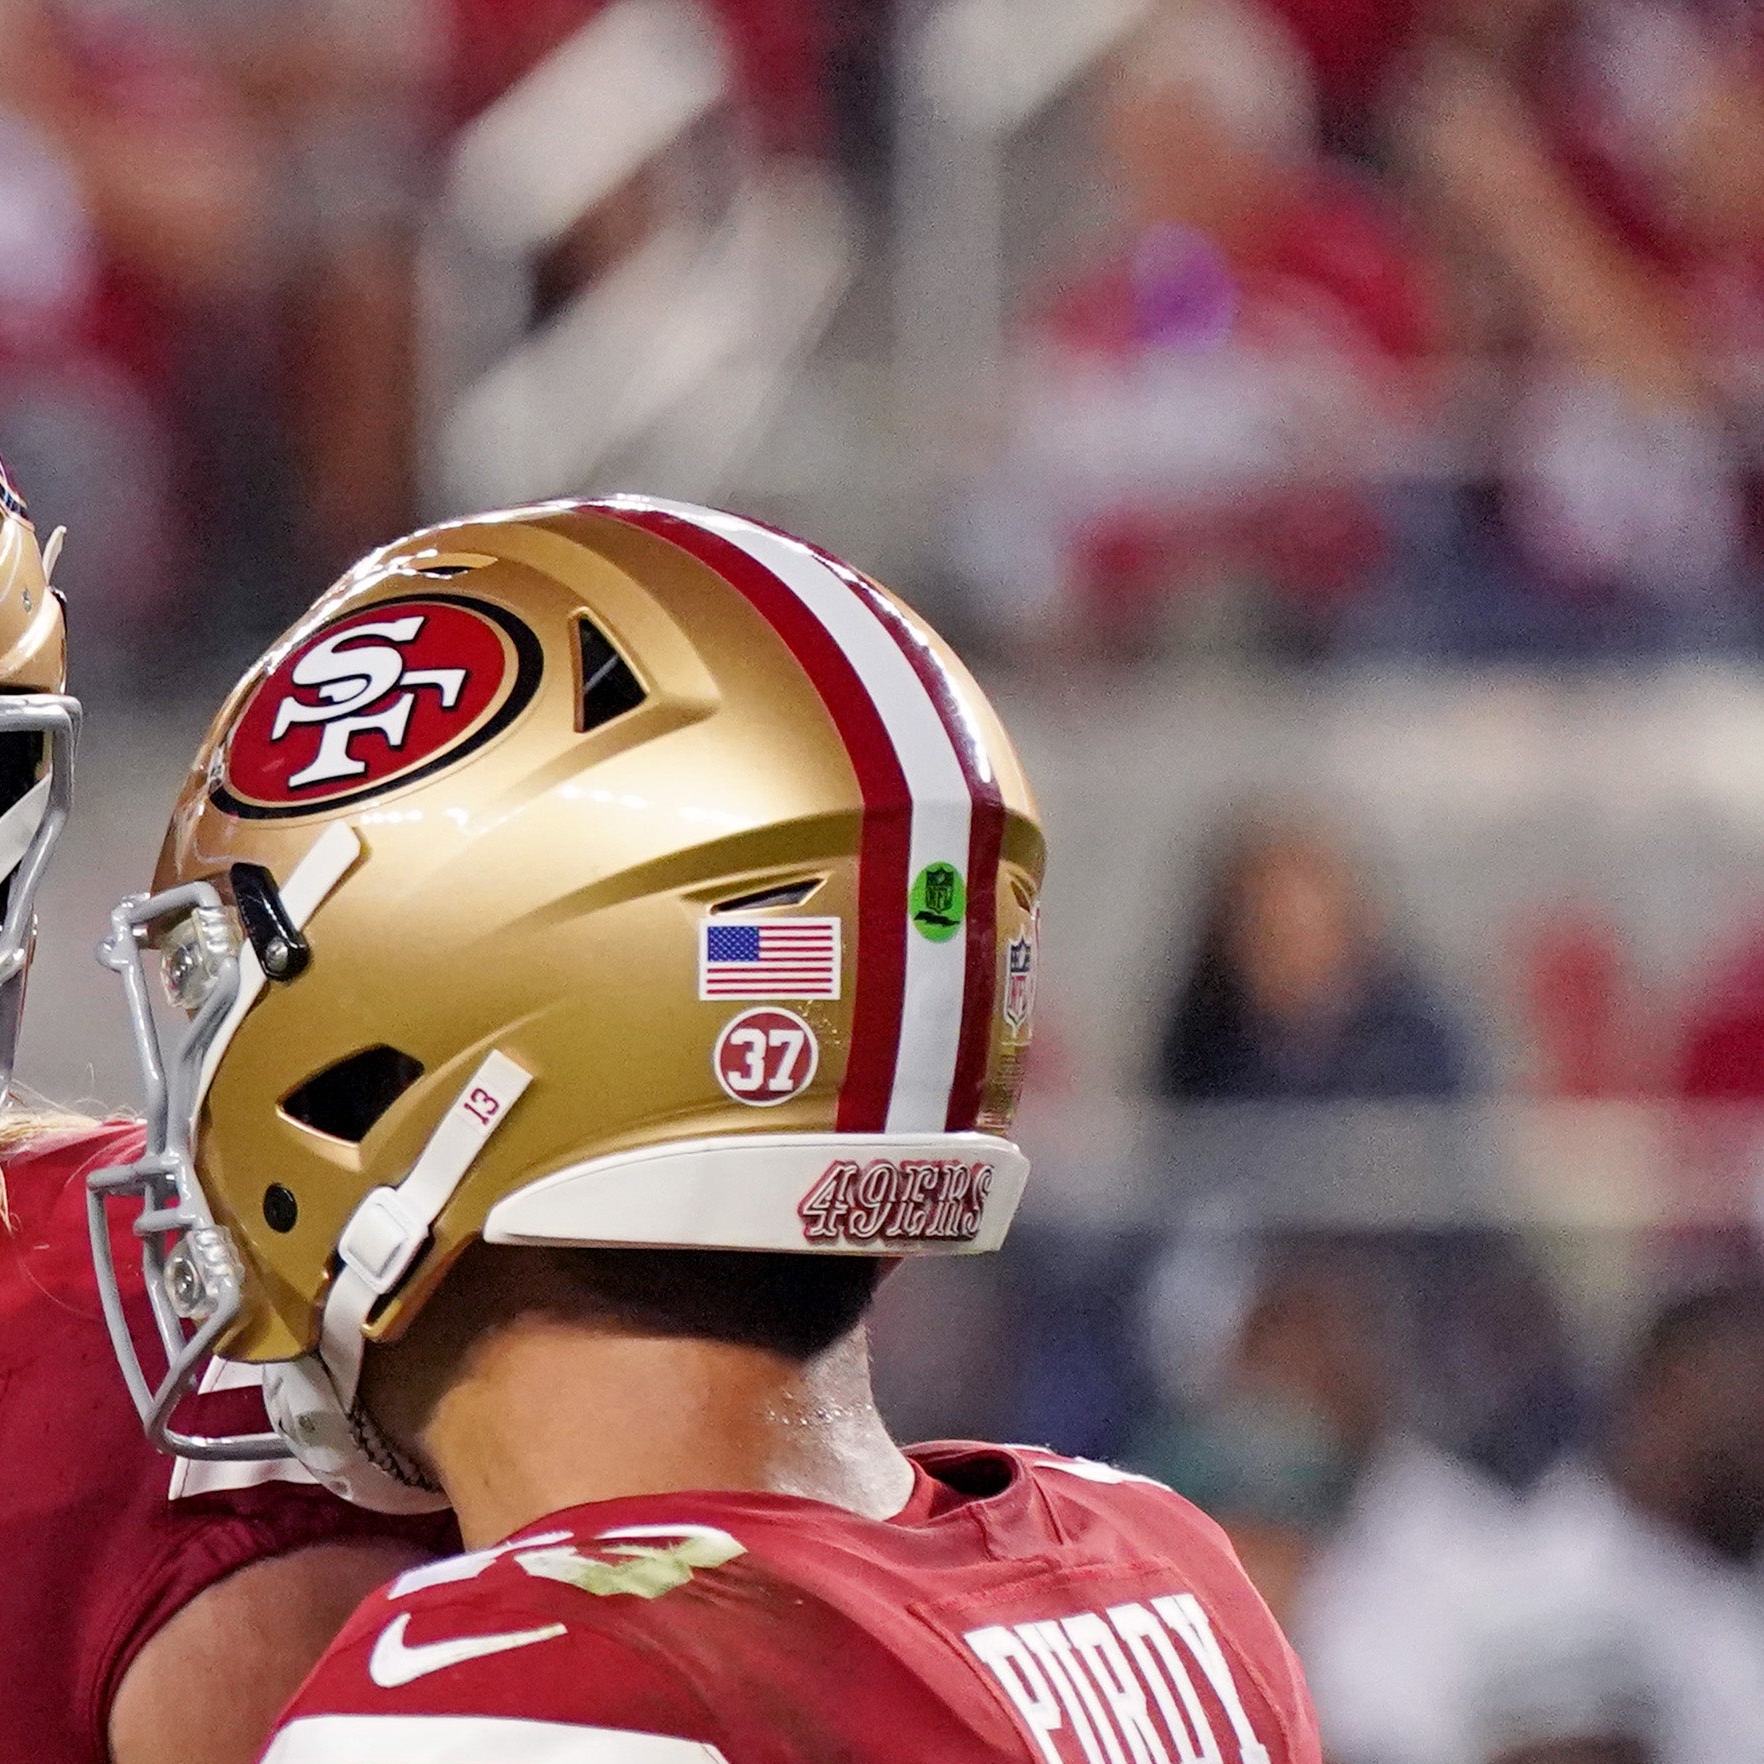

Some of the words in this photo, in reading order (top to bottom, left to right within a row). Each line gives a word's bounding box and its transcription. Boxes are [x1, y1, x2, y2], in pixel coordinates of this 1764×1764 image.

[270, 616, 467, 787] SF
[727, 1028, 805, 1091] 37
[464, 1088, 500, 1125] 13
[797, 1159, 995, 1241] 49ERS
